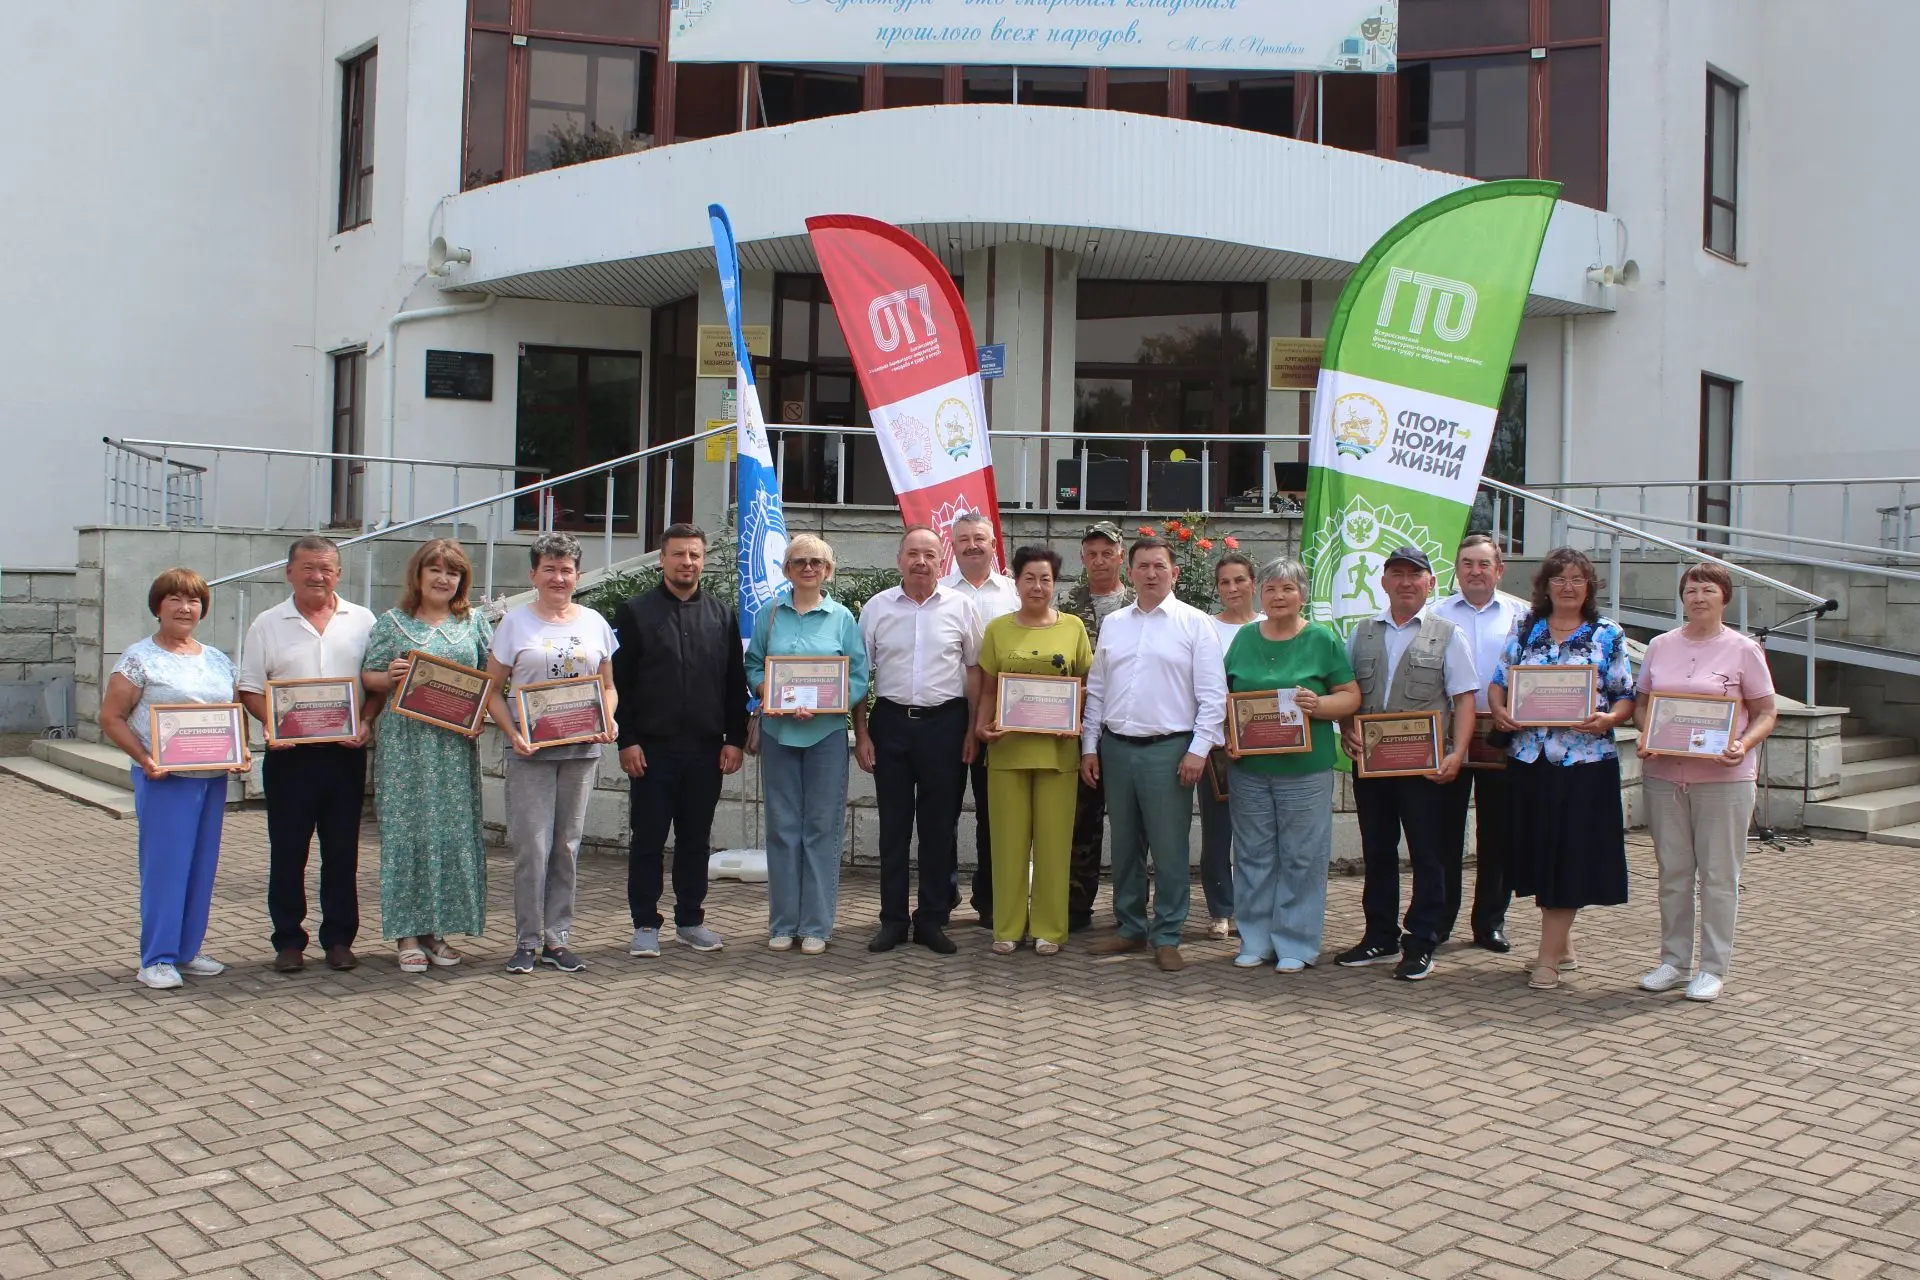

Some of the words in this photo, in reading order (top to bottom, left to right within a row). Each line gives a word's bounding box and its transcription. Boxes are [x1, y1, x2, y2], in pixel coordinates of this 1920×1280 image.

[875, 25, 982, 49] прошлого
[990, 17, 1039, 42] всех
[1046, 19, 1142, 51] народов.
[1239, 36, 1305, 56] Пришвин
[1376, 267, 1478, 342] ГТО
[1397, 410, 1459, 439] СПОРТ
[1392, 428, 1467, 461] НОРМА
[1387, 447, 1462, 480] ЖИЗНИ
[429, 681, 475, 699] СЕРТИФИКАТ
[179, 727, 227, 735] СЕРТИФИКАТ
[1382, 735, 1427, 743] СЕРТИФИКАТ
